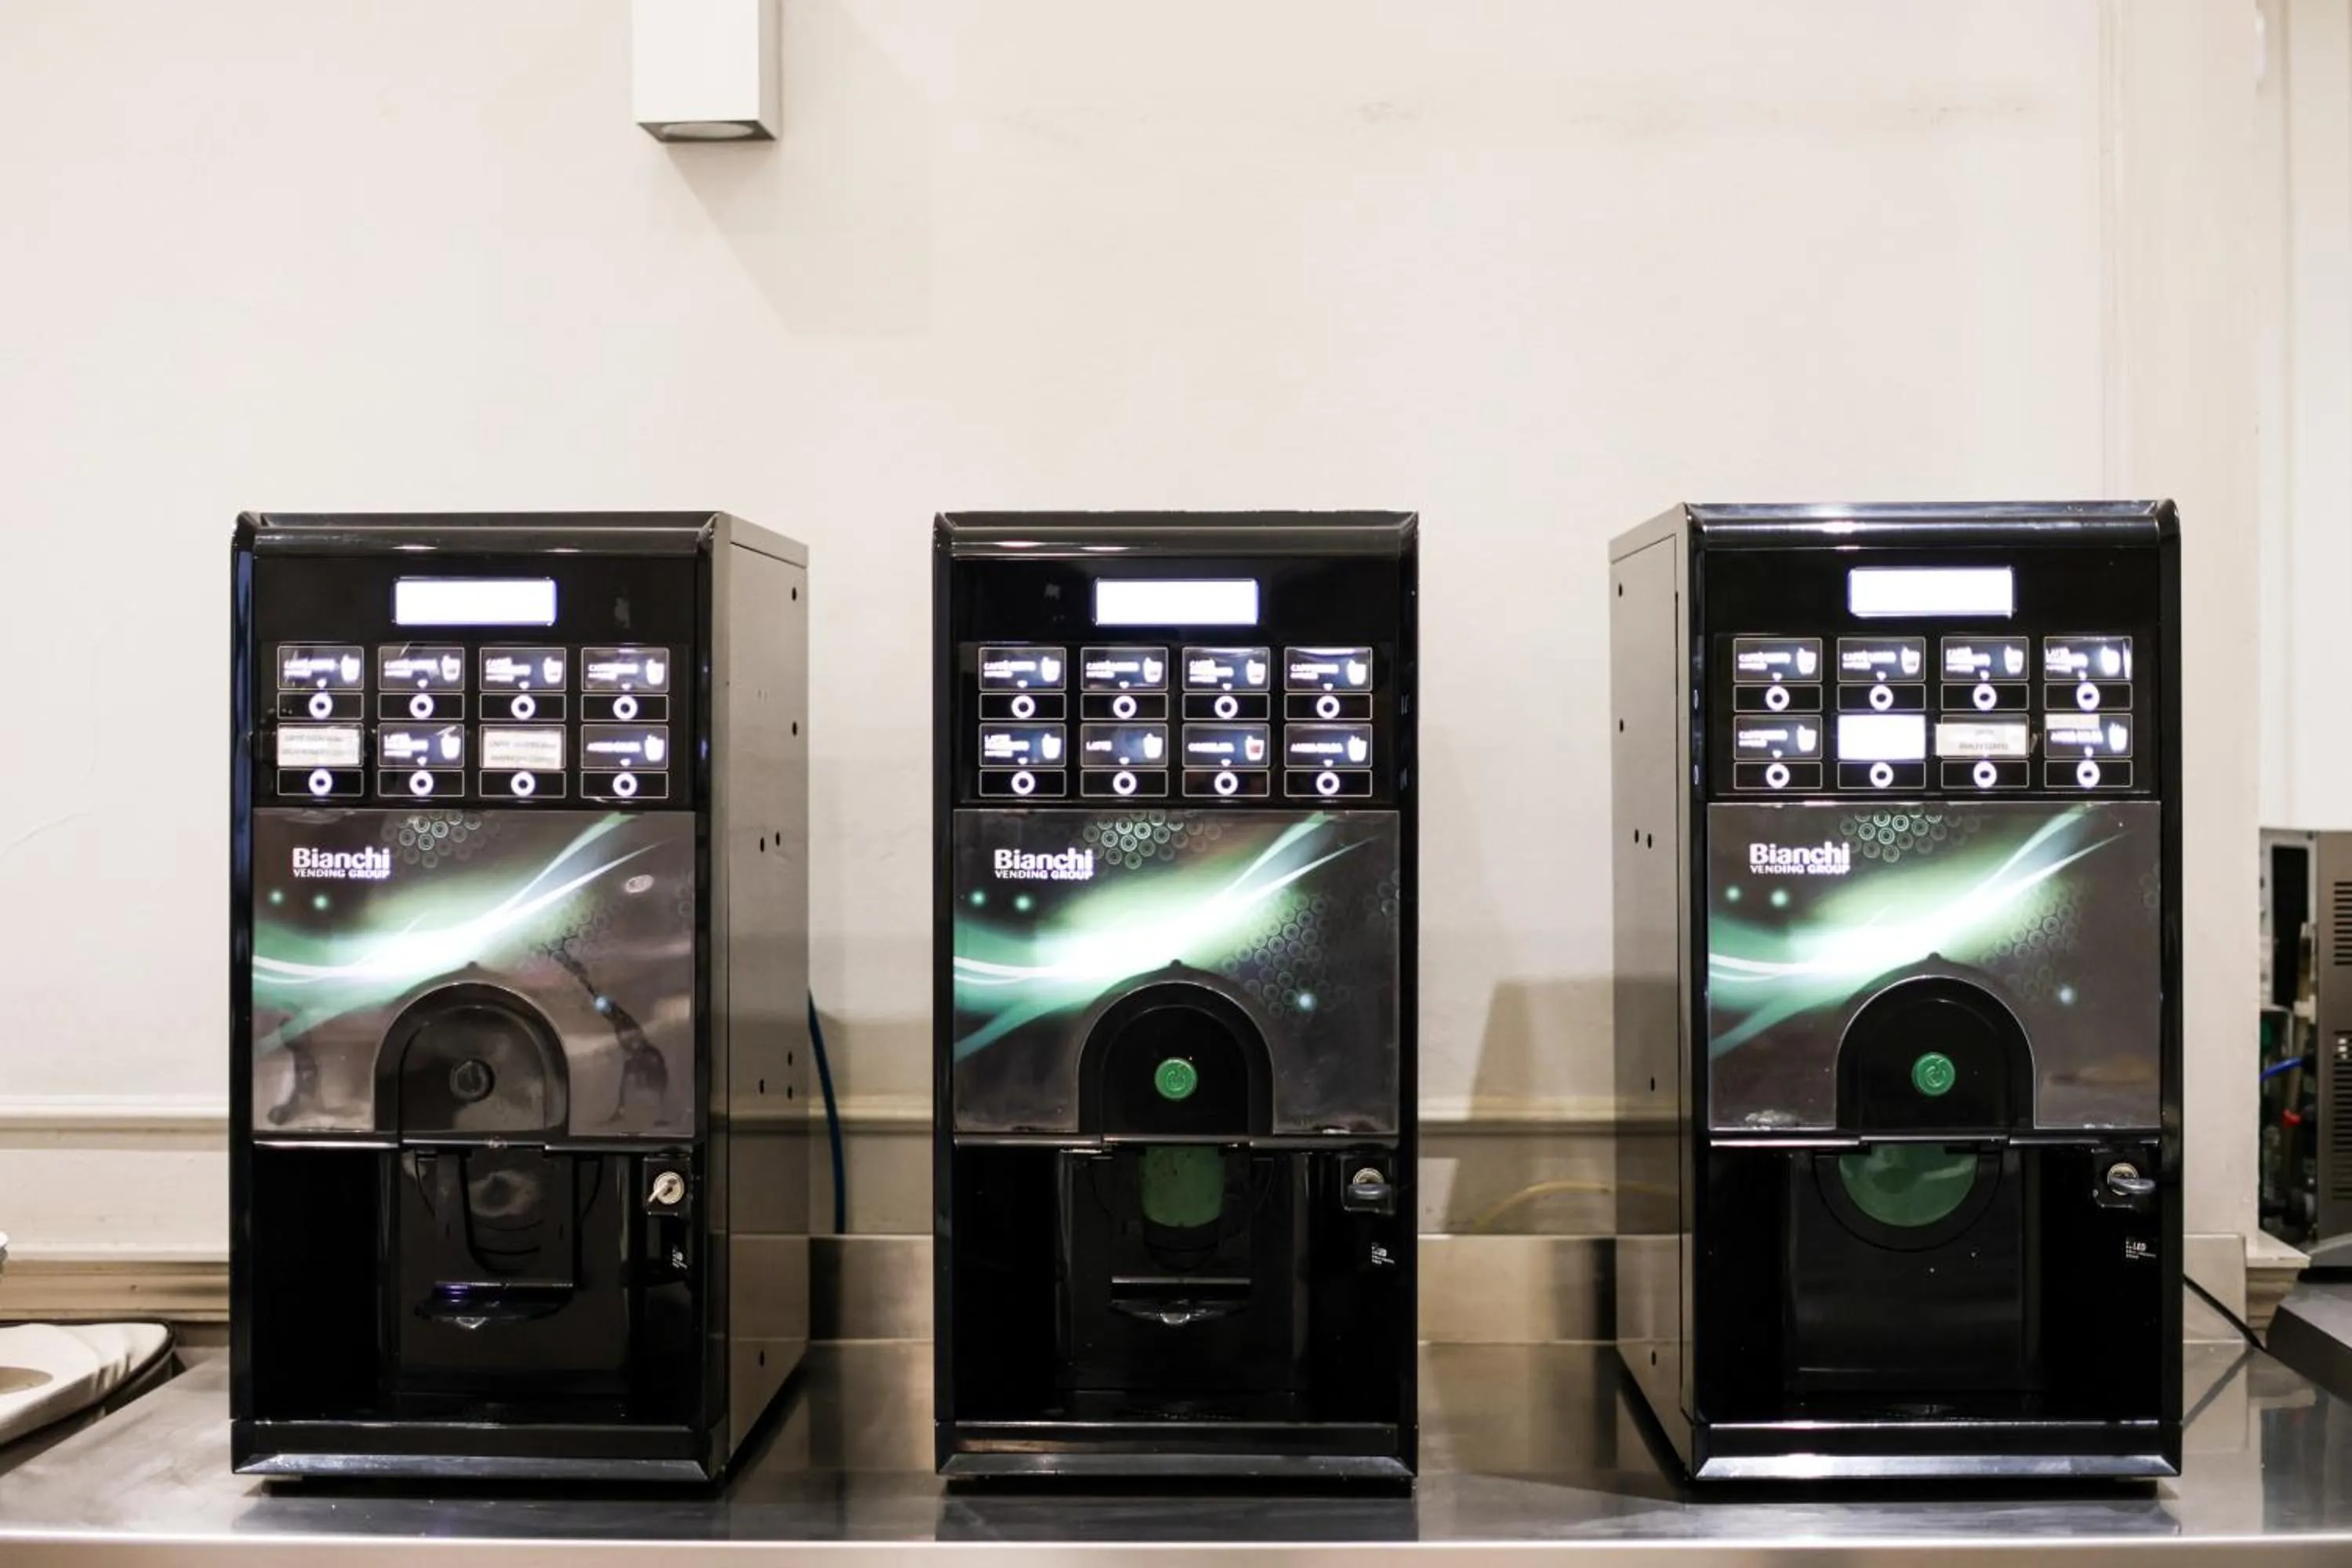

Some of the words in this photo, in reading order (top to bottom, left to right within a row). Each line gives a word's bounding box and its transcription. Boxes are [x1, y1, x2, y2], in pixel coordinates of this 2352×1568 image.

[292, 847, 390, 869] Bianchi
[994, 848, 1093, 870] Bianchi
[1749, 840, 1849, 864] Bianchi
[292, 868, 346, 878] VENDING
[348, 869, 390, 879] GROUP
[994, 869, 1048, 879] VENDING
[1051, 869, 1094, 880] GROUP
[1750, 864, 1805, 874] VENDING
[1806, 864, 1850, 875] GROUP
